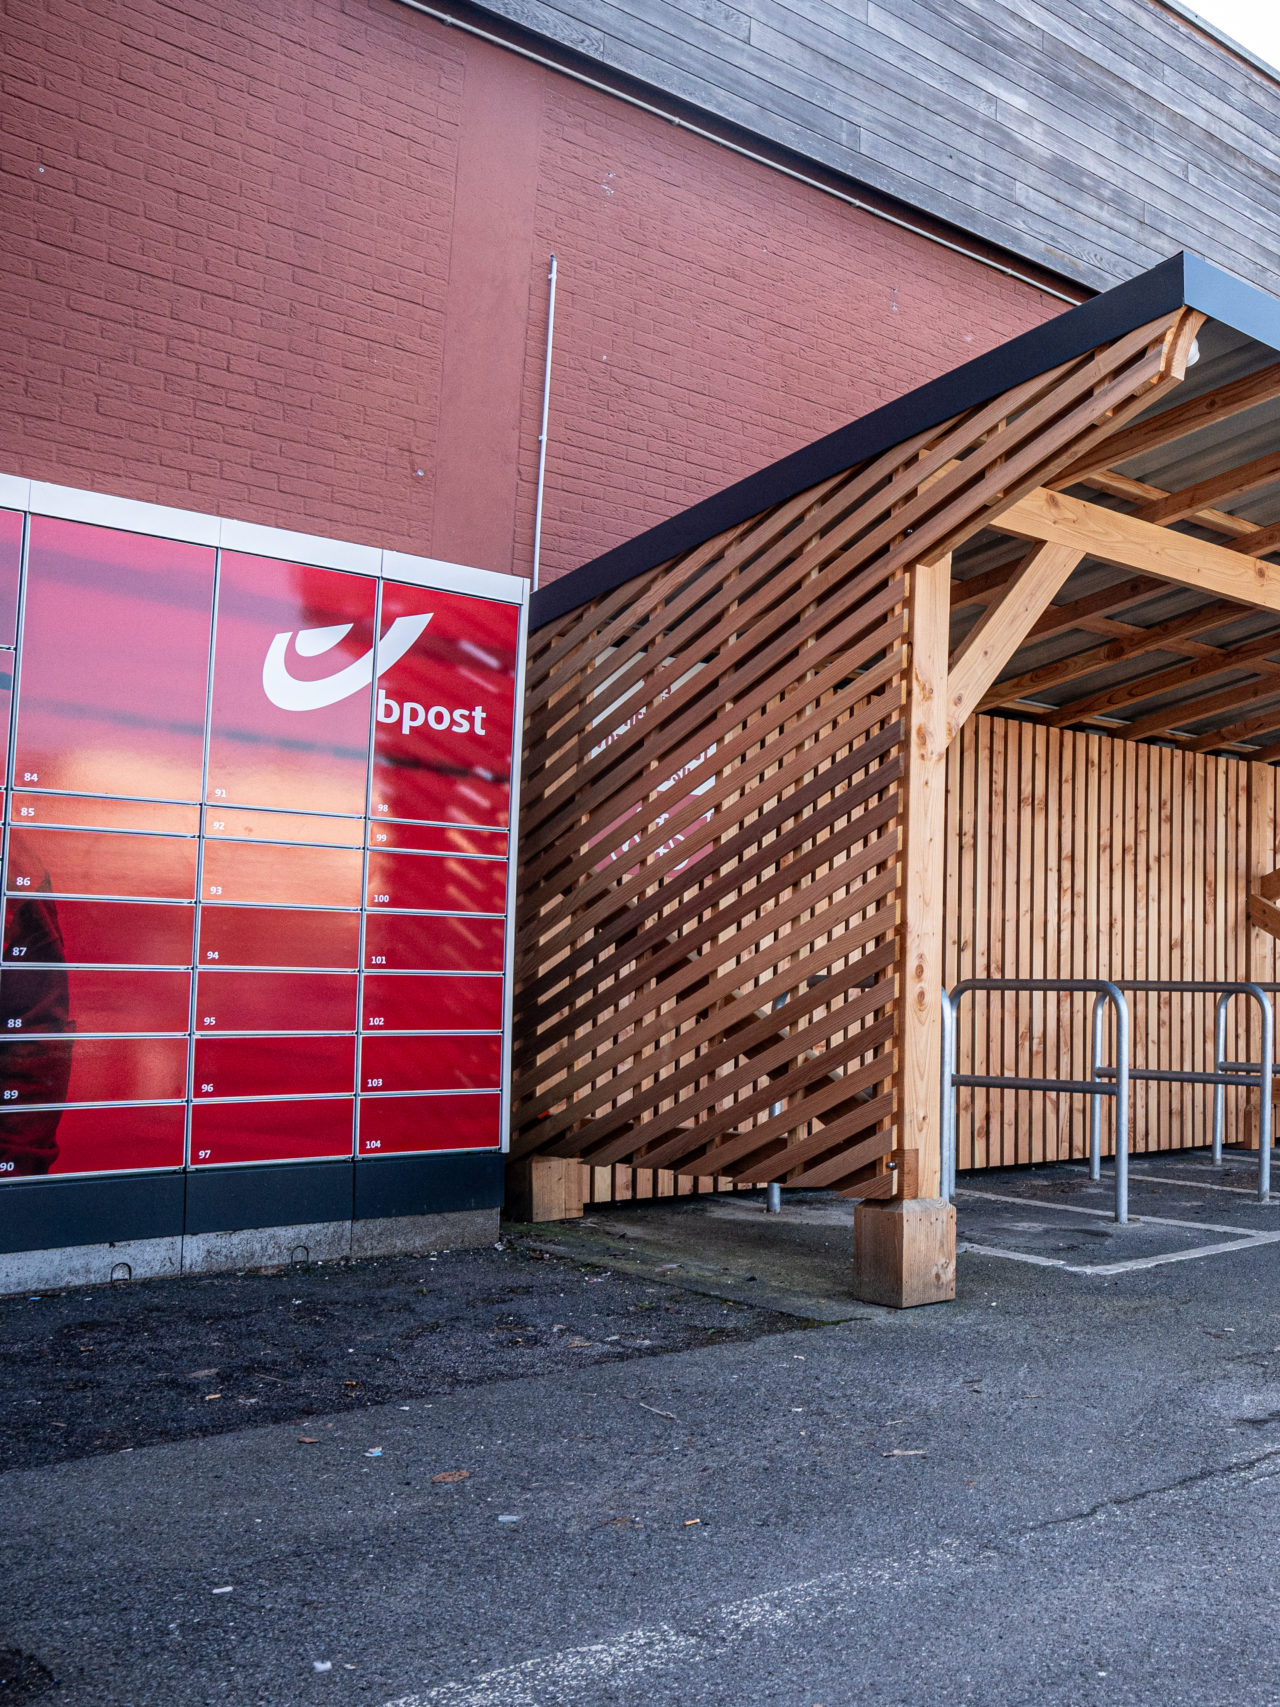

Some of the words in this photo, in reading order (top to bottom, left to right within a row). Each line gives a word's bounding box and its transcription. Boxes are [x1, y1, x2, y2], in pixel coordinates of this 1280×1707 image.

[376, 688, 487, 736] bpost
[23, 772, 39, 782] 84
[215, 788, 227, 798] 91
[20, 807, 35, 817] 85
[377, 803, 389, 812] 98
[213, 821, 225, 830] 92
[375, 833, 387, 842] 99
[16, 876, 31, 886] 86
[210, 886, 222, 895] 93
[373, 894, 389, 903] 100
[12, 946, 27, 956] 87
[207, 951, 219, 960] 94
[371, 955, 387, 965] 101
[7, 1018, 22, 1028] 88
[203, 1016, 216, 1026] 95
[369, 1017, 385, 1026] 102
[201, 1083, 214, 1092] 96
[367, 1078, 383, 1087] 103
[3, 1089, 19, 1100] 89
[365, 1140, 381, 1149] 104
[198, 1149, 211, 1159] 97
[0, 1161, 15, 1172] 90
